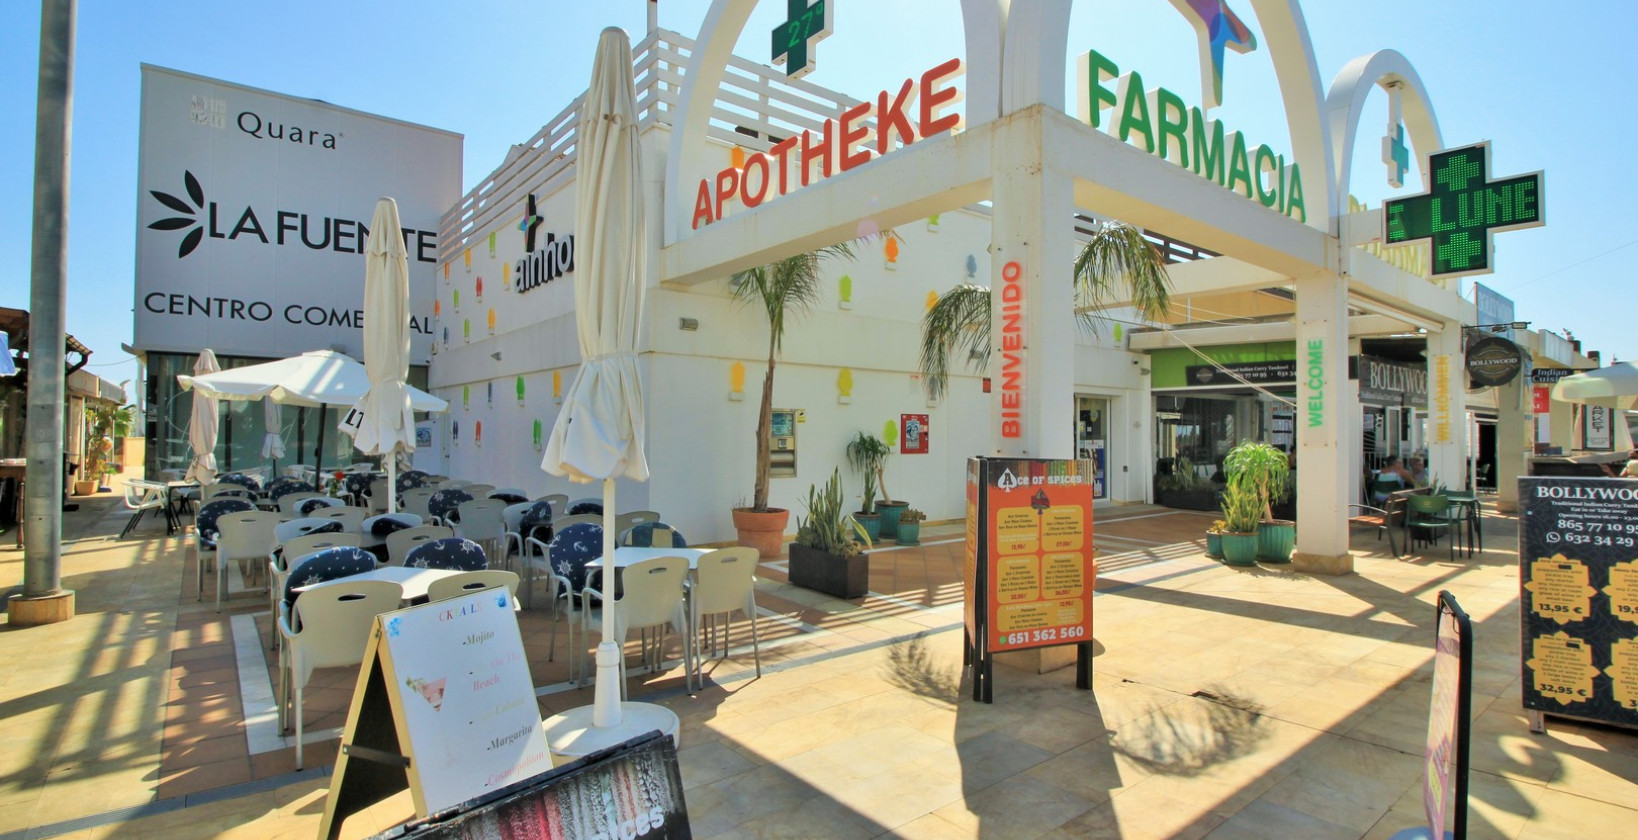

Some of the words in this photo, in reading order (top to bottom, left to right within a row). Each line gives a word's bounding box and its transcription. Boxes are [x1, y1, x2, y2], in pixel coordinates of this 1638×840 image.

[236, 111, 337, 150] Quara
[691, 57, 963, 231] APOTHEKE
[1082, 48, 1307, 224] FARMACIA
[209, 201, 270, 244] LA
[1431, 180, 1536, 233] LUNE
[513, 233, 575, 293] ainho
[144, 291, 274, 321] CENTRO
[283, 304, 434, 335] COMEAL
[1001, 260, 1022, 438] BIENVENIDO
[1470, 357, 1518, 366] BOLLYWOOD
[1307, 339, 1324, 428] WELCOME
[1370, 361, 1428, 394] BOLLYWOO
[1532, 375, 1559, 383] Cuisi
[1538, 368, 1567, 377] Indian
[1558, 519, 1584, 531] 865
[1586, 522, 1603, 532] 77
[1607, 523, 1622, 531] 10
[1564, 532, 1591, 544] 632
[1594, 535, 1612, 545] 34
[1616, 537, 1634, 547] 29
[1539, 603, 1569, 613] 13,95
[1573, 606, 1583, 614] €
[1008, 631, 1029, 645] 651
[1033, 628, 1056, 641] 362
[1060, 626, 1084, 639] 560
[473, 672, 502, 693] Beach
[1540, 683, 1573, 695] 32,95
[1577, 688, 1587, 697] €
